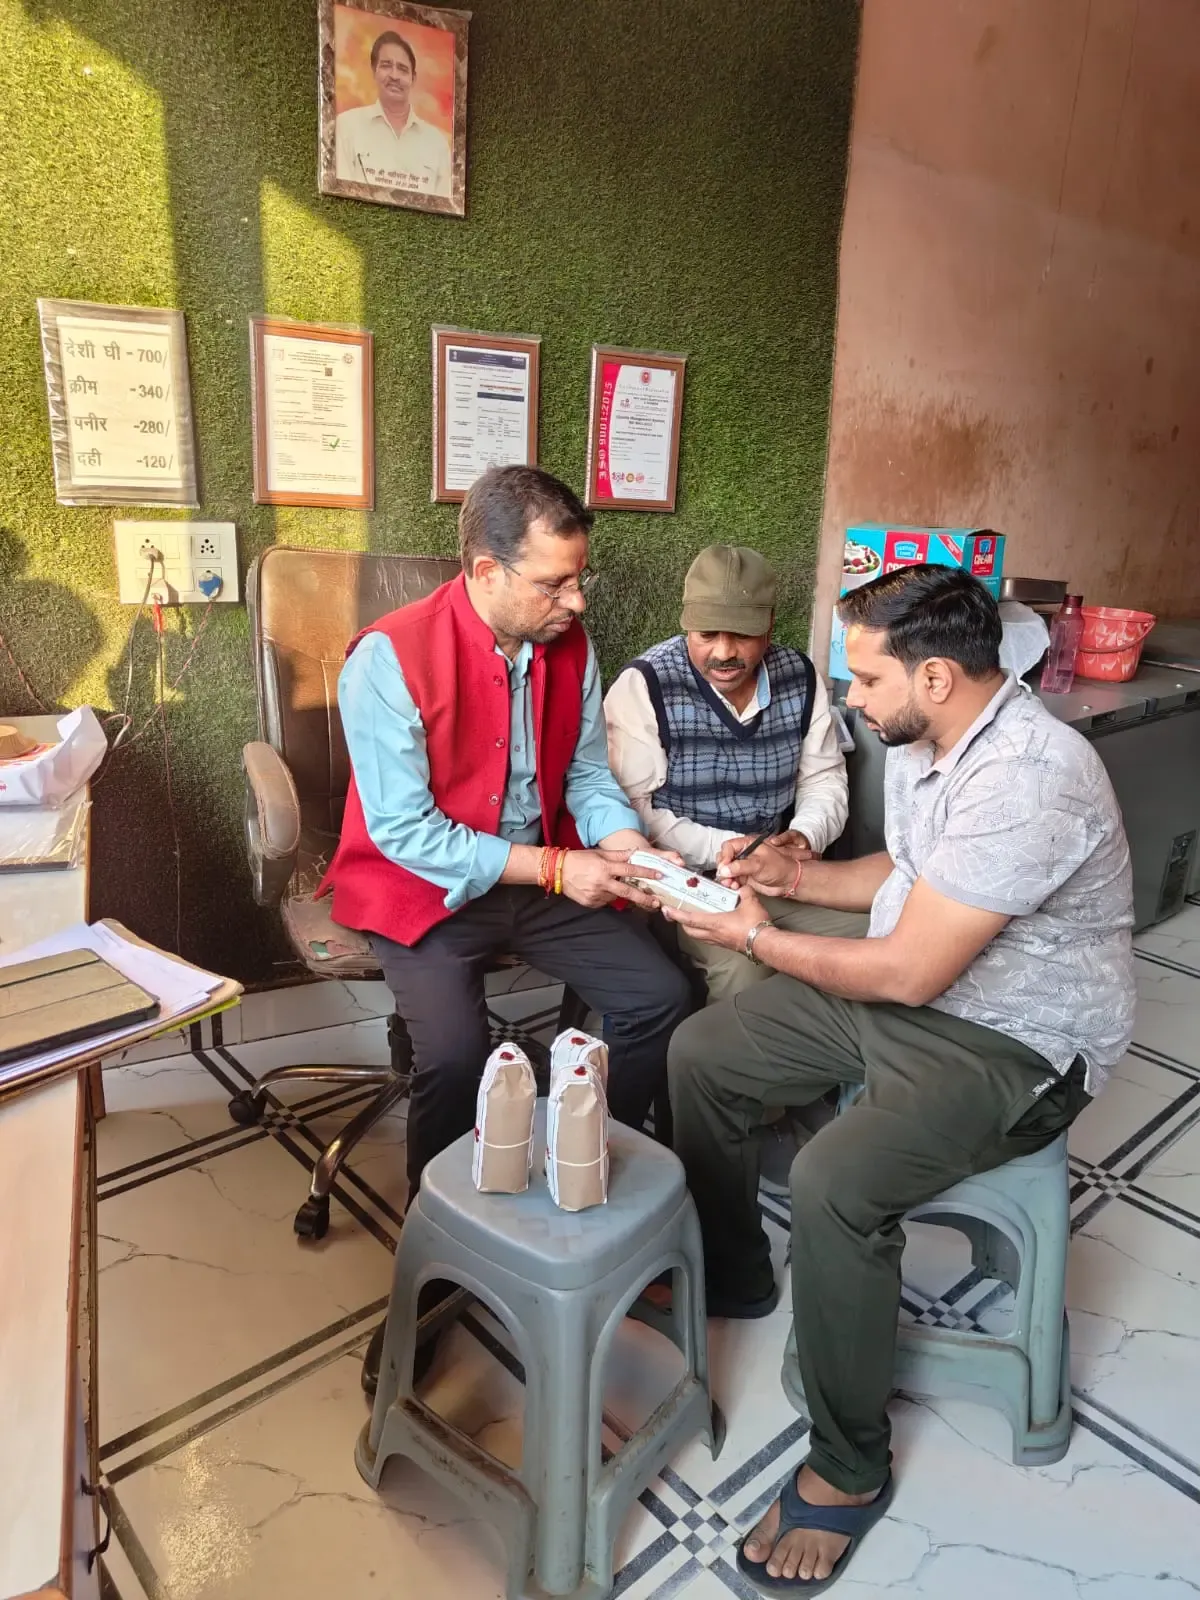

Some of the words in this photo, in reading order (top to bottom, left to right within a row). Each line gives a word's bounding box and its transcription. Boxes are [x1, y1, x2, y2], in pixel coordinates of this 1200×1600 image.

[64, 337, 95, 359] देशी
[103, 341, 121, 361] घी
[67, 375, 98, 395] क्रीम
[73, 412, 108, 431] पनीर
[76, 448, 102, 467] दही
